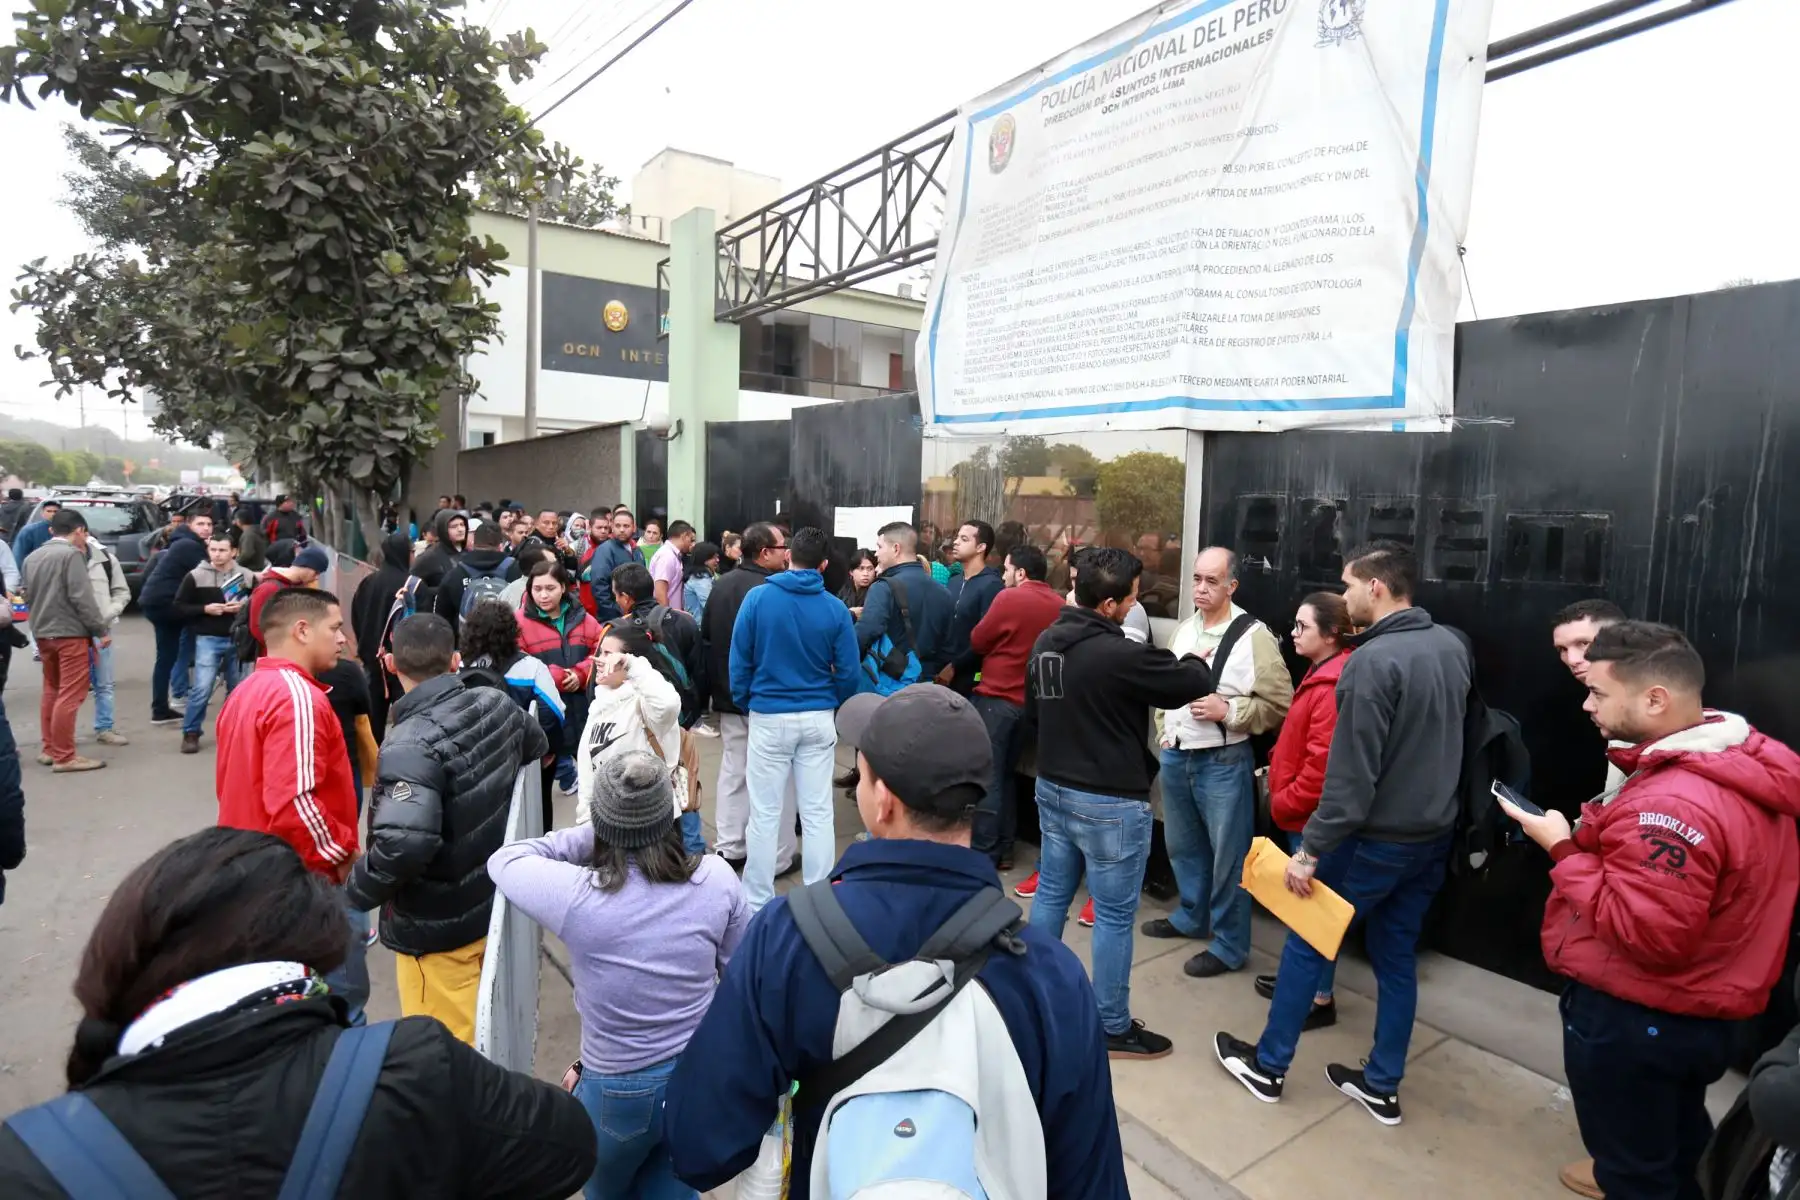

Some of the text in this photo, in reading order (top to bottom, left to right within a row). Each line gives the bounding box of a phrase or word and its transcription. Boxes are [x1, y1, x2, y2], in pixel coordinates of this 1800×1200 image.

[1041, 72, 1096, 112] POLICÍA
[1100, 34, 1187, 88] NACIONAL
[1193, 16, 1227, 49] DEL
[1094, 95, 1107, 108] DE
[1110, 72, 1157, 100] ASUNTOS
[1159, 28, 1274, 79] INTERNACIONALES
[1101, 77, 1186, 116] OCN INTERPOL LIMA
[1248, 162, 1266, 173] POR
[1277, 148, 1313, 170] CONCEPTO
[1314, 147, 1326, 157] DE
[1328, 143, 1355, 157] FICHA
[1356, 140, 1369, 152] DE
[1201, 187, 1235, 198] PARTIDA
[1236, 188, 1248, 198] DE
[1327, 172, 1334, 182] Y
[1334, 171, 1352, 182] DNI
[1354, 167, 1371, 180] DEL
[1190, 228, 1214, 237] FICHA
[1215, 228, 1227, 237] DE
[1273, 226, 1280, 234] Y
[1280, 215, 1339, 234] ODONTOGRAMA
[1190, 240, 1207, 250] CON
[1209, 240, 1219, 250] LA
[1293, 227, 1348, 244] FUNCIONARIO
[1349, 225, 1362, 236] DE
[1363, 225, 1375, 236] LA
[1203, 264, 1261, 275] PROCEDIENDO
[1262, 264, 1271, 273] AL
[1304, 254, 1315, 265] DE
[1316, 253, 1334, 264] LOS
[1224, 290, 1235, 299] AL
[1236, 286, 1290, 299] CONSULTORIO
[1181, 311, 1226, 323] REALIZARLE
[1227, 313, 1238, 323] LA
[1239, 313, 1263, 323] TOMA
[1264, 312, 1275, 322] DE
[1275, 305, 1321, 320] IMPRESIONES
[1180, 335, 1190, 344] AL
[1215, 338, 1227, 347] DE
[1227, 337, 1266, 347] REGISTRO
[1266, 336, 1277, 346] DE
[1277, 335, 1300, 346] DATOS
[1300, 332, 1320, 341] PARA
[1322, 331, 1333, 340] LA
[563, 342, 669, 365] OCN INTE
[1178, 375, 1213, 387] TERCERO
[1213, 377, 1253, 388] MEDIANTE
[1254, 377, 1279, 387] CARTA
[1280, 375, 1306, 387] PODER
[1306, 373, 1349, 386] NOTARIAL.
[1638, 812, 1705, 846] BROOKLYN
